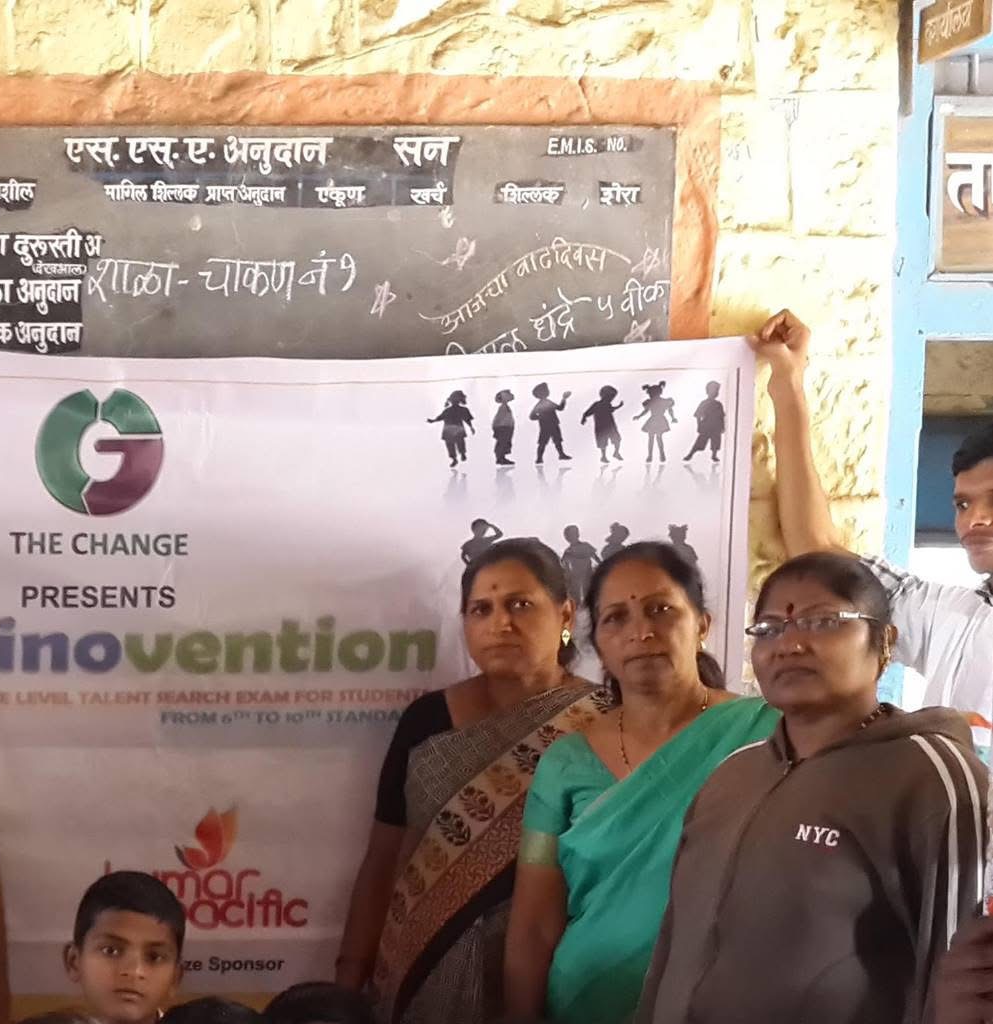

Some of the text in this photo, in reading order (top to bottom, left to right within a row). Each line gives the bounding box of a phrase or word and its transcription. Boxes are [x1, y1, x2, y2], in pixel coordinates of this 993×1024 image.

[223, 135, 334, 175] अनुदान
[393, 136, 461, 167] सन
[547, 136, 628, 156] E.M.I.S. NO.
[104, 178, 149, 203] मागिल
[410, 181, 448, 205] खर्च
[500, 182, 564, 204] शिल्लक
[198, 257, 297, 301] चाकण
[16, 277, 83, 315] अनुदान
[14, 320, 84, 353] अनुदान
[9, 531, 189, 556] THE CHANGE
[21, 585, 176, 609] PRESENTS
[15, 690, 73, 705] LEVEL
[80, 690, 153, 705] TALENT
[157, 689, 231, 705] SEARCH
[236, 689, 290, 705] EXAM
[295, 689, 334, 704] FOR
[160, 710, 218, 725] FROM
[257, 710, 281, 725] TO
[327, 709, 403, 724] STANDA
[795, 823, 840, 847] NYC
[185, 888, 308, 930] acific
[209, 955, 284, 974] Sponsor
